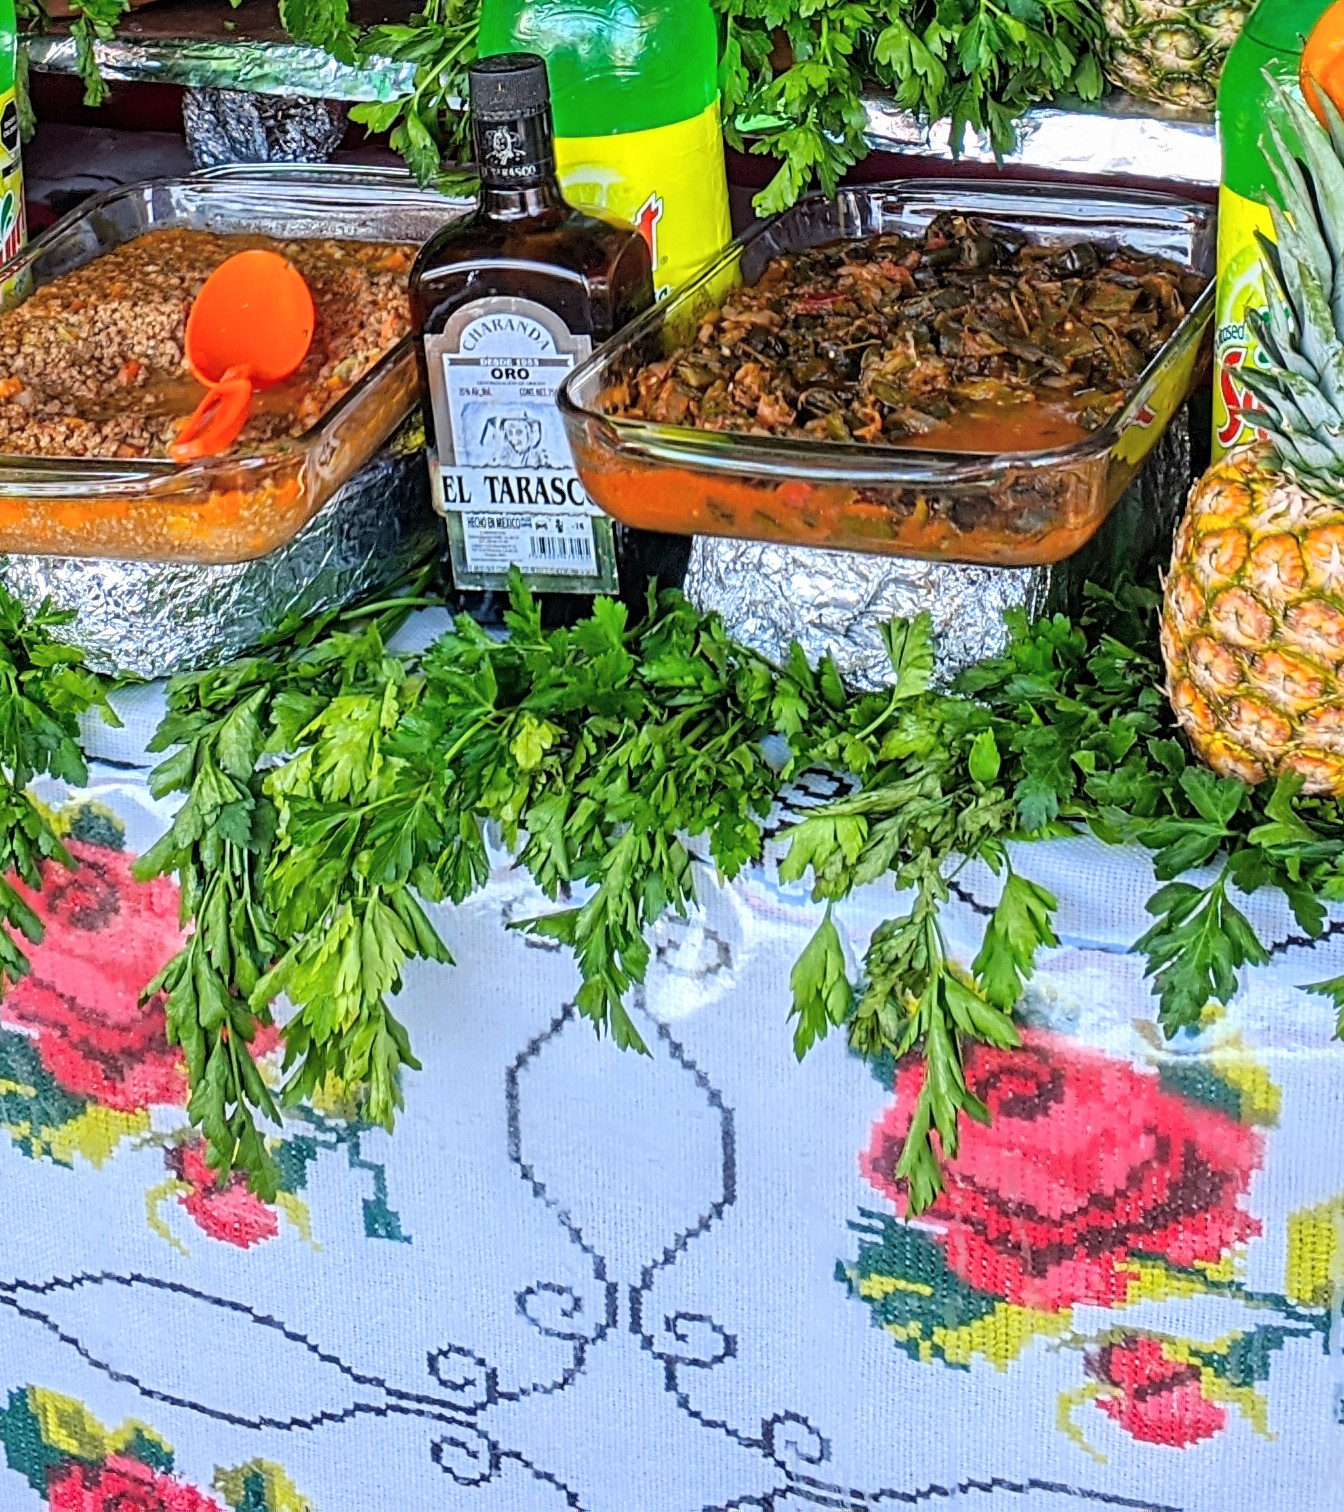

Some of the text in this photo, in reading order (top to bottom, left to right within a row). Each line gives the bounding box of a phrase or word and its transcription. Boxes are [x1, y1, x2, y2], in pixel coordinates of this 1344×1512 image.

[462, 318, 550, 352] CHARANDA
[490, 368, 530, 380] ORO
[442, 475, 472, 504] EL
